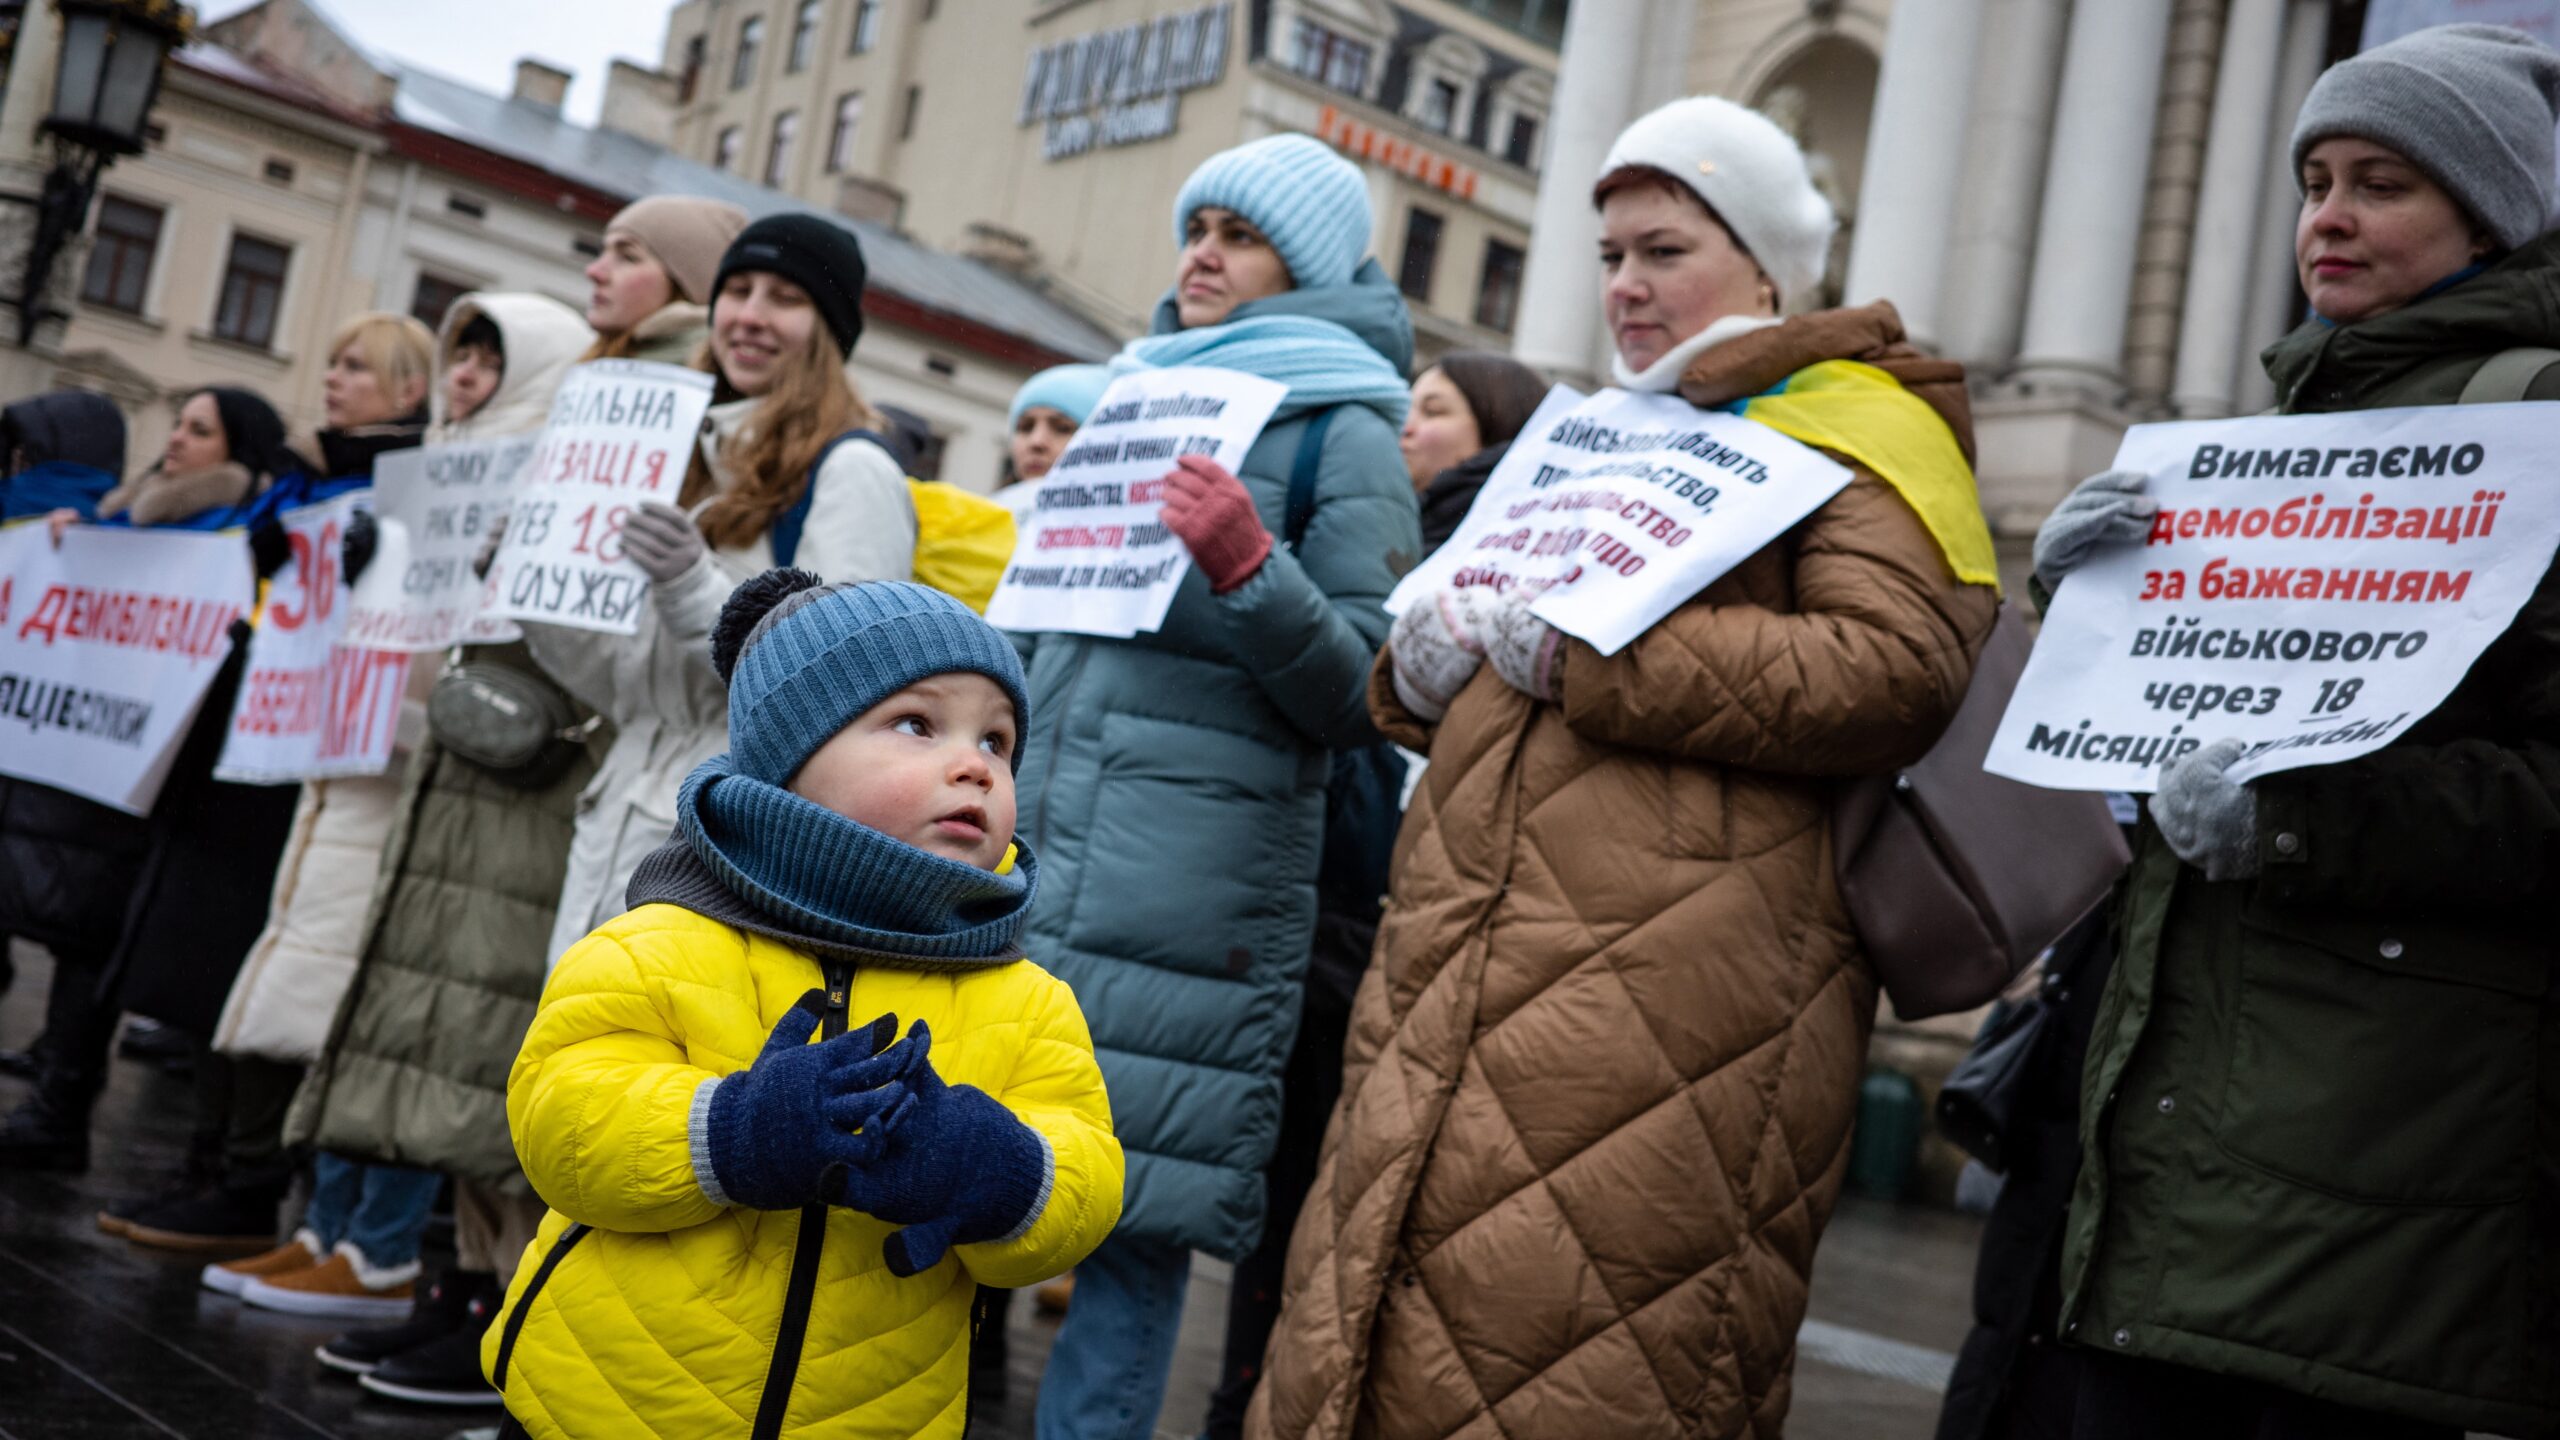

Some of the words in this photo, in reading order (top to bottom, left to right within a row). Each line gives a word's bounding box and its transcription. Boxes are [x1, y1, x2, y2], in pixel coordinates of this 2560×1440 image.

[2188, 442, 2485, 480] Вимагаємо
[2147, 490, 2506, 545] демобілізації
[510, 560, 652, 625] СЛУЖБИ
[2138, 569, 2186, 601] за
[2199, 557, 2473, 602] бажанням
[2129, 615, 2429, 662] військового
[2143, 681, 2282, 720] через
[2309, 677, 2364, 715] 18
[2240, 711, 2411, 761] лужби!
